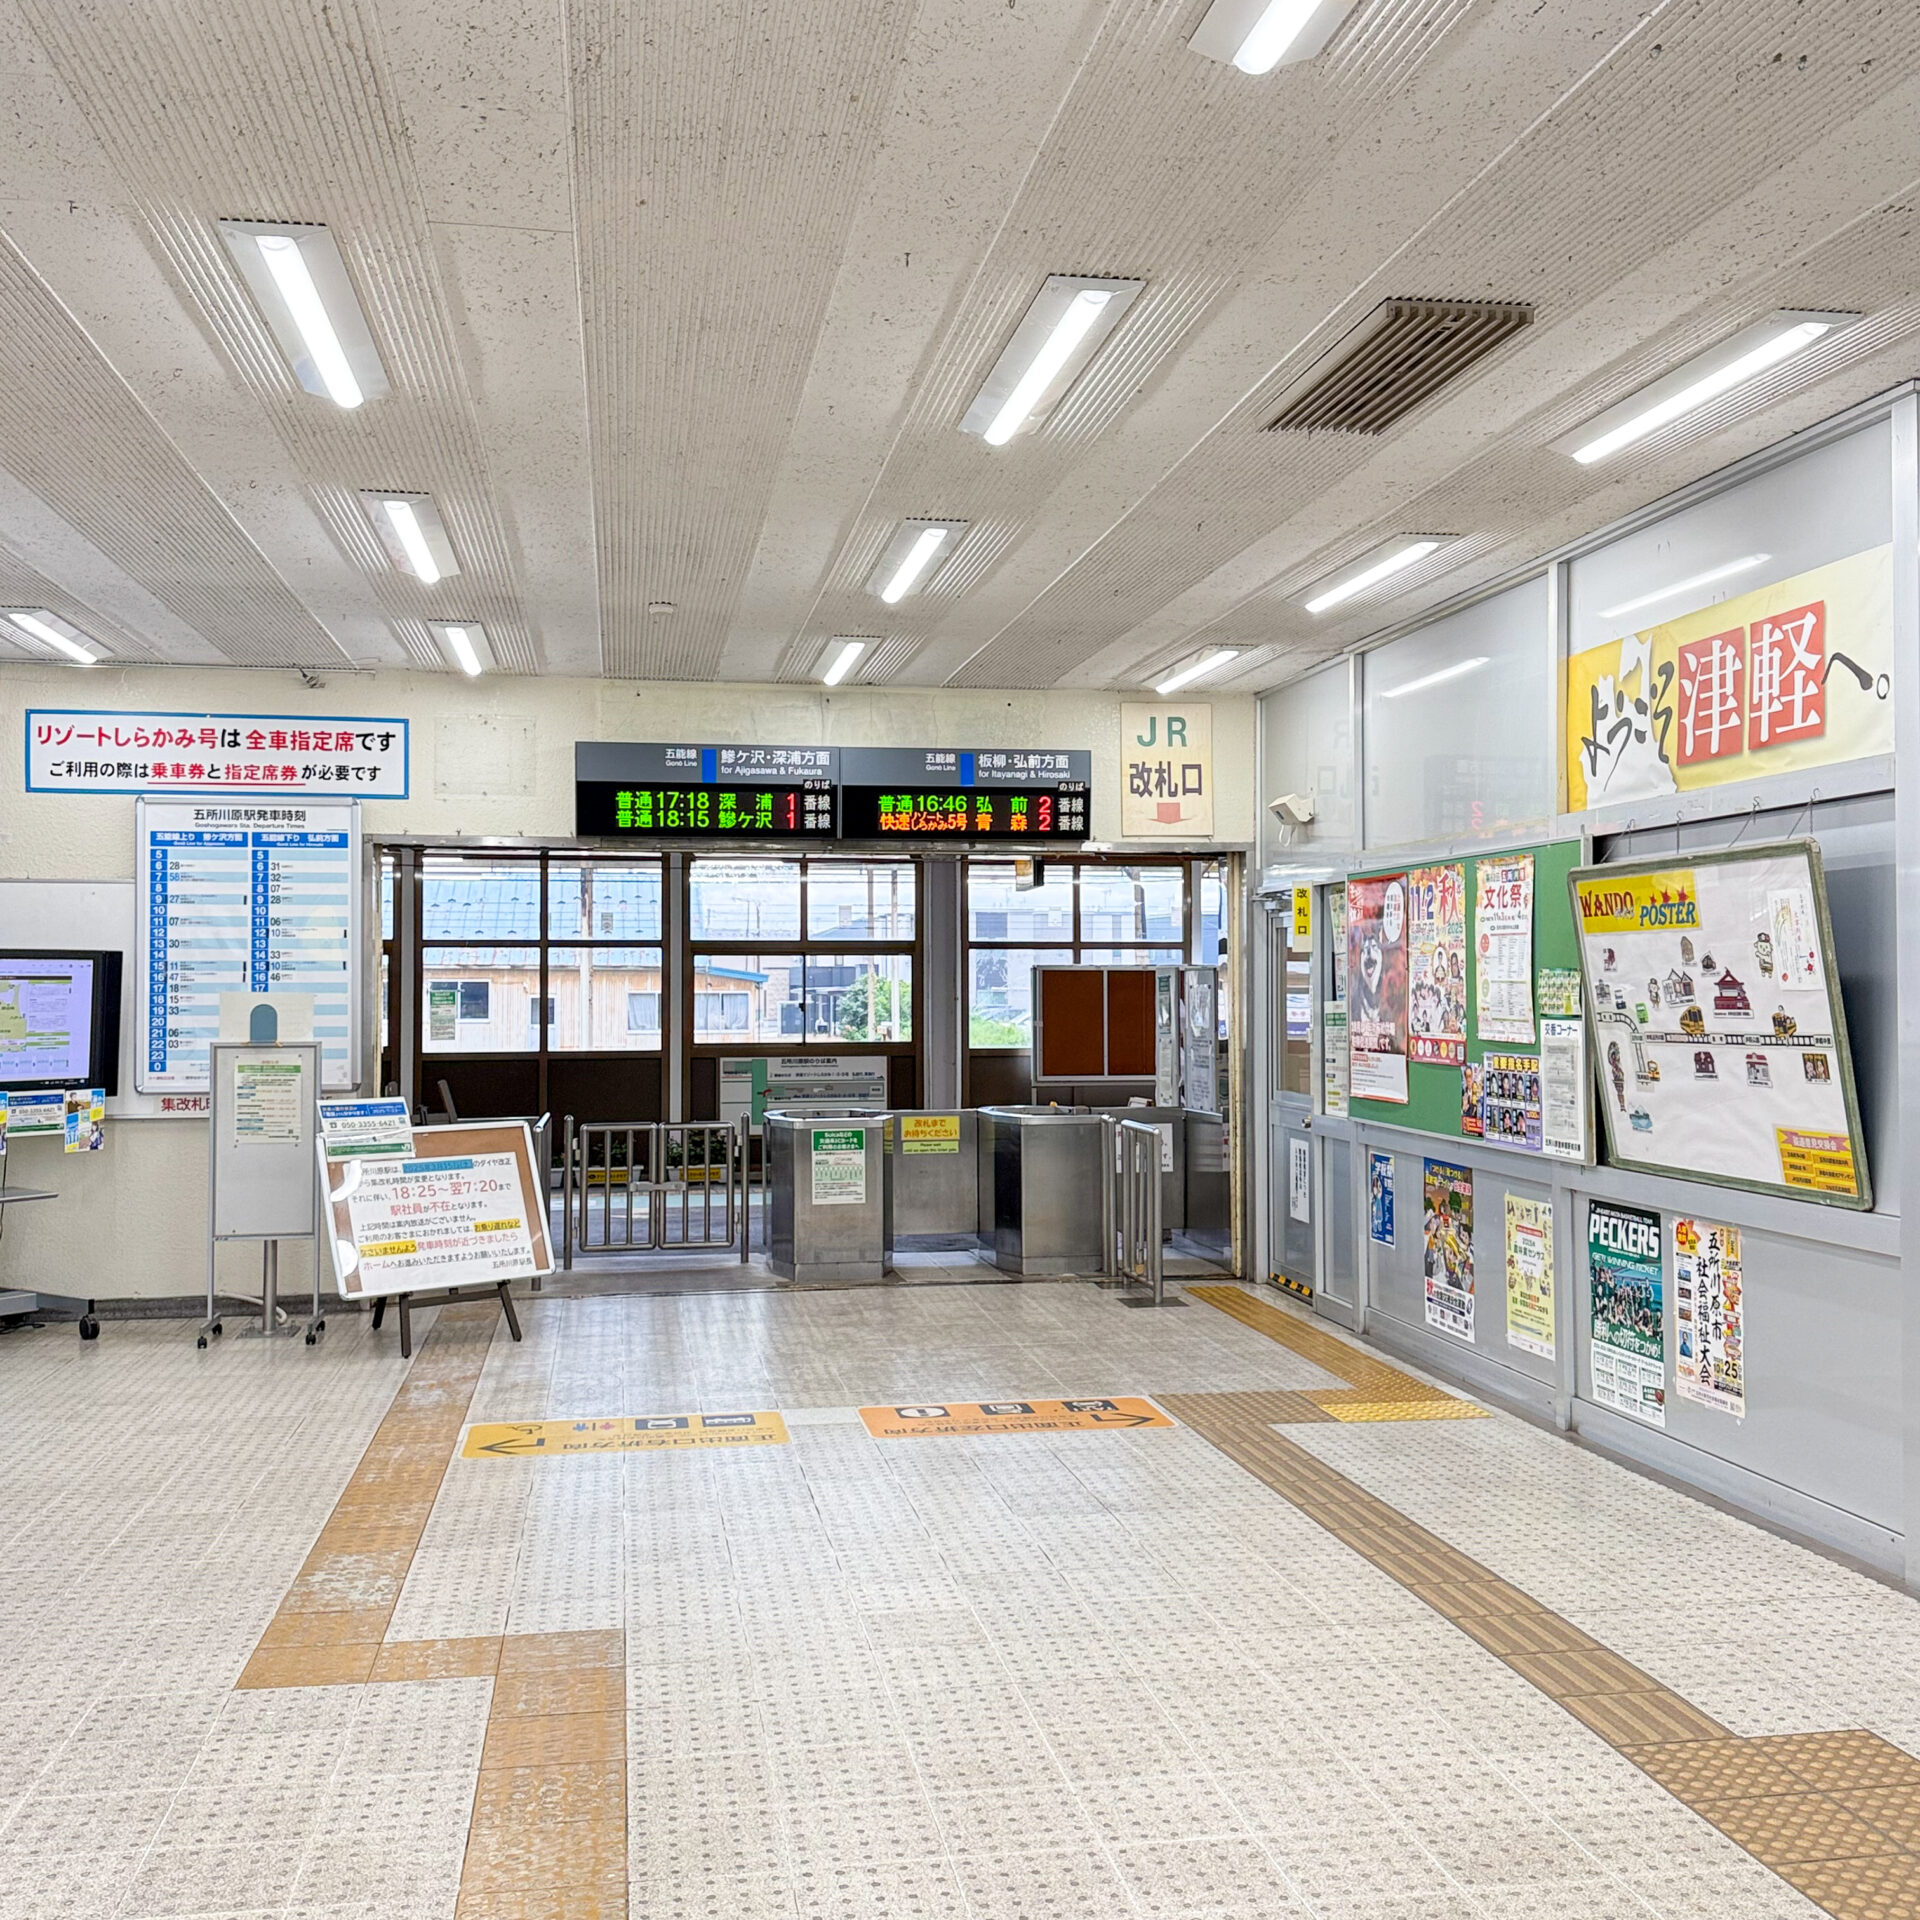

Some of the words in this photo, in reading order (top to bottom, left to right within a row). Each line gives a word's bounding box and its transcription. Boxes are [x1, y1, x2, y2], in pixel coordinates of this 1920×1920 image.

[1137, 716, 1187, 747] JR
[36, 725, 396, 752] リゾートしらかみ号は全車指定席です
[665, 748, 697, 759] 五能線
[925, 754, 956, 764] 五能線
[978, 754, 1069, 769] 板柳・弘前方面
[49, 761, 382, 782] ご利用の際は乗車券と指定席券が必要です
[721, 766, 733, 775] for
[734, 766, 778, 777] Ajigasawa
[779, 767, 786, 776] &
[788, 767, 822, 776] Fukaura
[978, 770, 990, 778] for
[991, 770, 1028, 780] Itayanagi
[1038, 770, 1070, 779] Hirosaki
[1129, 761, 1202, 798] 改札口
[804, 780, 831, 790] のりば
[1059, 782, 1084, 792] のりば
[616, 791, 652, 809] 普通
[656, 792, 710, 808] 17:18
[718, 793, 736, 810] 深
[756, 793, 773, 811] 浦
[787, 793, 795, 810] 1
[804, 794, 831, 811] 番線
[878, 795, 912, 812] 普通
[918, 796, 967, 812] 16:46
[976, 796, 992, 813] 弘
[1010, 796, 1028, 813] 前
[1039, 796, 1050, 813] 2
[1058, 798, 1084, 814] 番線
[194, 809, 306, 822] 五所川原駅発車時刻
[616, 811, 652, 828] 普通
[656, 811, 710, 827] 18:15
[787, 812, 795, 828] 1
[804, 813, 831, 829] 番線
[976, 813, 992, 831] 青
[1010, 813, 1028, 831] 森
[1039, 815, 1050, 831] 2
[1058, 816, 1084, 831] 番線
[156, 851, 163, 859] 5
[257, 851, 264, 859] 5
[156, 862, 163, 870] 6
[169, 862, 180, 870] 28
[257, 862, 264, 870] 6
[271, 862, 281, 870] 31
[155, 872, 163, 880] 7
[169, 872, 180, 881] 58
[257, 873, 264, 881] 7
[271, 873, 281, 881] 32
[155, 884, 163, 892] 8
[257, 884, 264, 892] 8
[271, 884, 281, 892] 07
[155, 895, 163, 903] 9
[169, 895, 180, 903] 27
[257, 895, 264, 903] 9
[271, 895, 281, 904] 28
[1484, 884, 1522, 910] 文化祭
[152, 906, 165, 914] 10
[254, 906, 266, 914] 10
[1296, 888, 1308, 935] 改札口
[1579, 890, 1634, 918] WANDO
[1640, 901, 1696, 926] POSTER
[152, 917, 165, 925] 11
[169, 917, 180, 926] 07
[254, 918, 266, 926] 11
[270, 918, 280, 926] 06
[152, 929, 165, 937] 12
[254, 929, 266, 937] 12
[270, 929, 280, 937] 10
[152, 940, 165, 948] 13
[169, 940, 179, 948] 30
[254, 940, 266, 948] 13
[152, 950, 164, 958] 14
[254, 951, 266, 959] 14
[270, 951, 280, 959] 33
[152, 962, 164, 970] 15
[169, 962, 179, 970] 11
[254, 962, 266, 970] 15
[270, 962, 280, 970] 10
[151, 974, 164, 982] 16
[169, 974, 179, 982] 47
[254, 973, 266, 981] 16
[270, 973, 280, 981] 46
[151, 984, 164, 992] 17
[169, 984, 179, 993] 18
[254, 984, 266, 992] 17
[151, 995, 164, 1003] 18
[169, 995, 179, 1004] 15
[151, 1007, 164, 1015] 19
[169, 1007, 179, 1015] 33
[151, 1018, 164, 1026] 20
[151, 1029, 164, 1037] 21
[168, 1029, 179, 1037] 06
[151, 1040, 164, 1048] 22
[168, 1040, 179, 1048] 03
[151, 1051, 164, 1059] 23
[154, 1063, 162, 1071] 0
[161, 1097, 210, 1112] 集改札
[904, 1129, 958, 1138] お待ちください
[1589, 1213, 1660, 1258] PECKERS
[1708, 1232, 1722, 1340] 五所川原市
[1696, 1256, 1712, 1386] 社会福祉大会
[1725, 1360, 1738, 1379] 25
